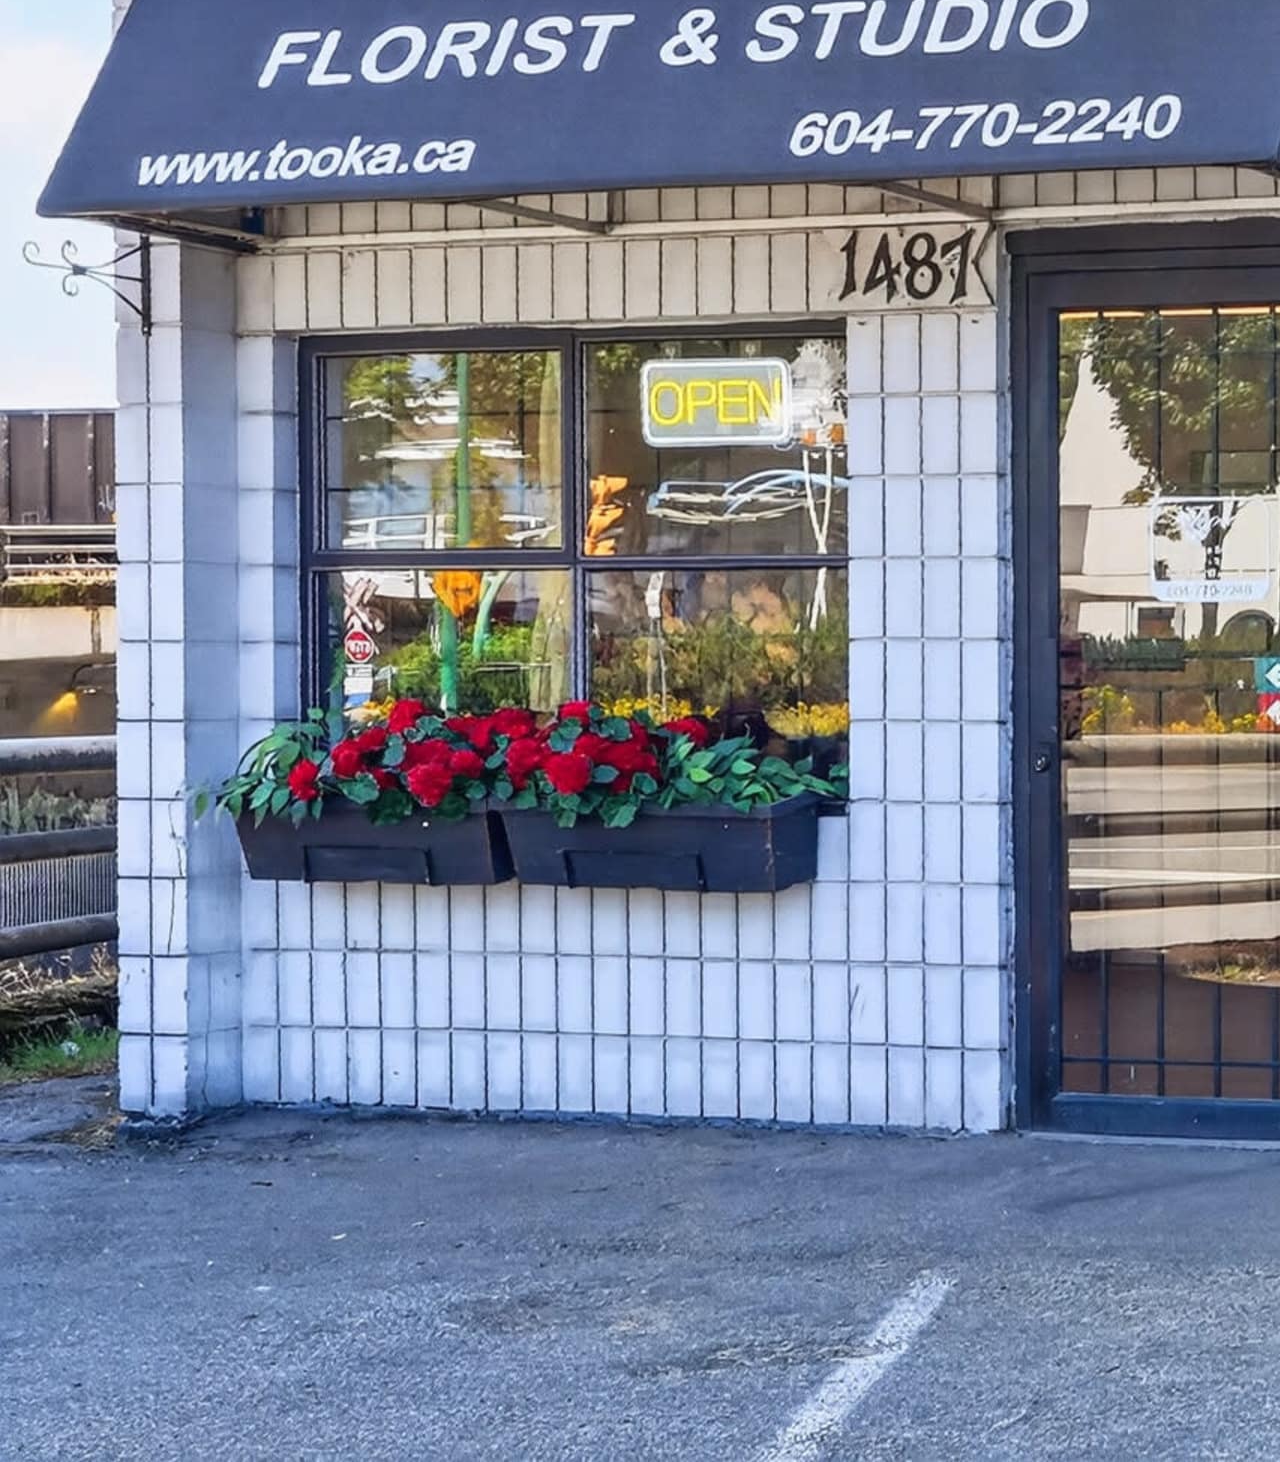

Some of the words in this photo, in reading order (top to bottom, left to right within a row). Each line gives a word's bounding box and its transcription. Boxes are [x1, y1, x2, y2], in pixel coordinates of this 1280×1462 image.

[257, 13, 636, 89] FLORIST
[659, 8, 719, 66] &
[789, 94, 1182, 157] 604-770-2240
[138, 134, 477, 186] www.tooka.ca
[650, 378, 782, 427] OPEN
